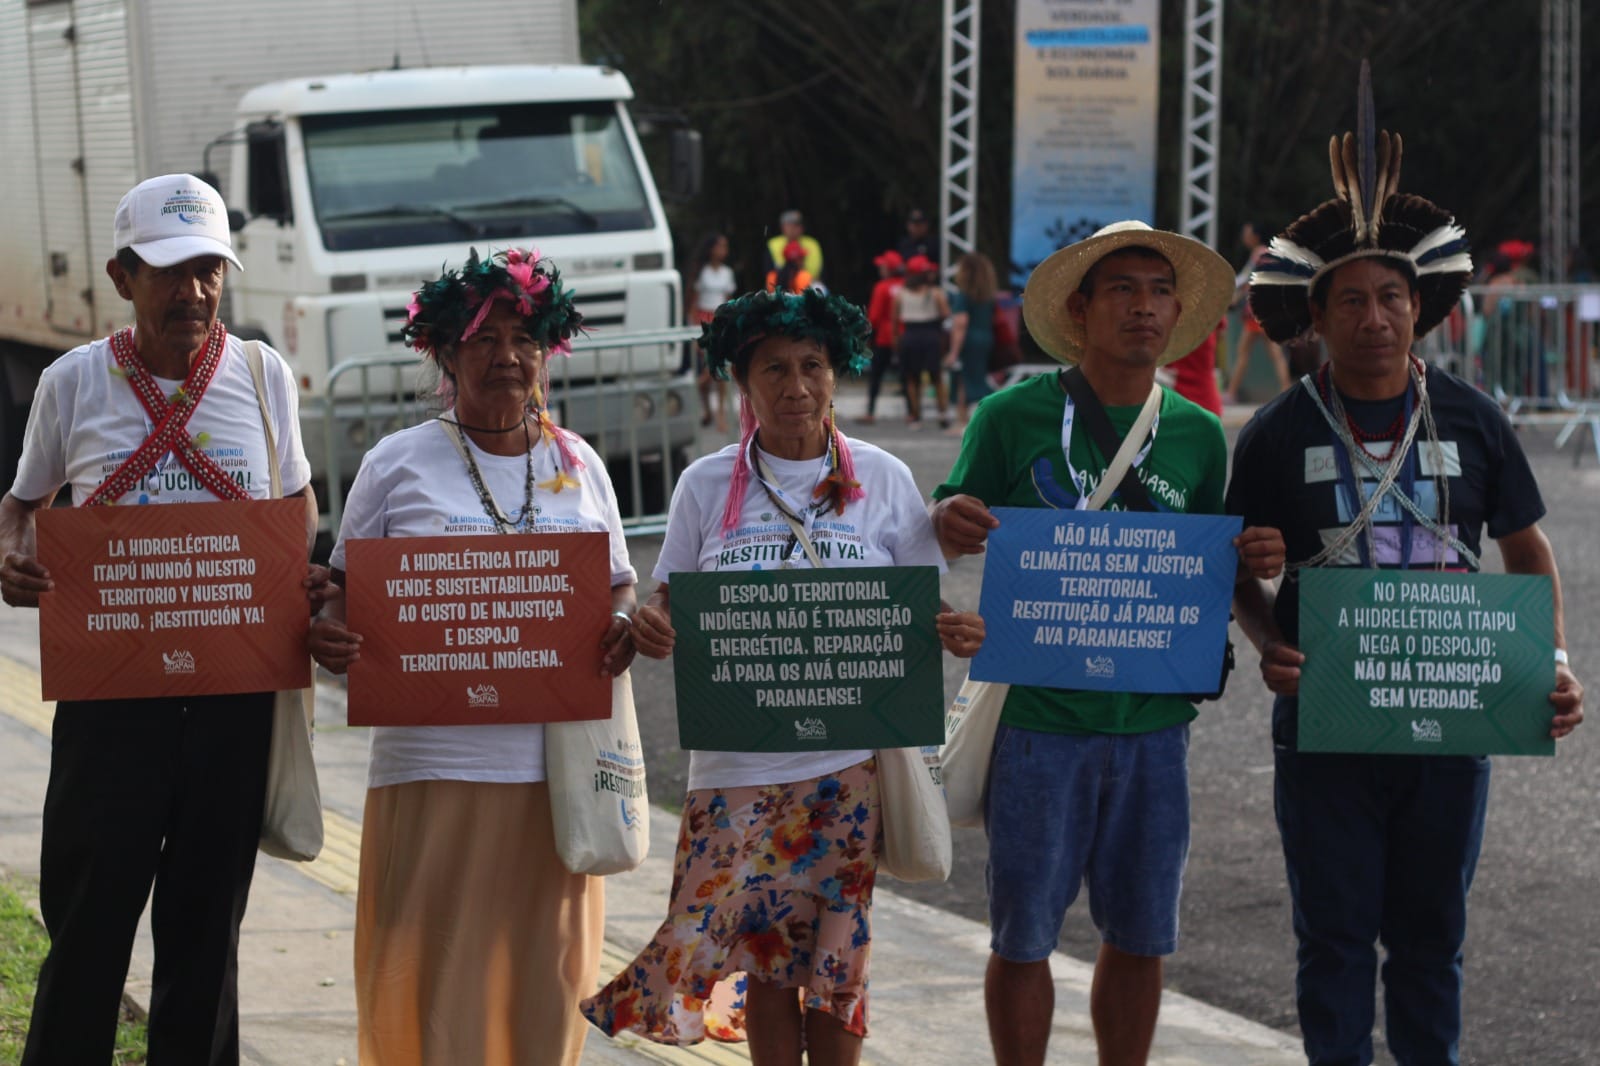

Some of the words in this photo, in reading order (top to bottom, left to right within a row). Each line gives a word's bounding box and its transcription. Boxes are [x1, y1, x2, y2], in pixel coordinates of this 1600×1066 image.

[221, 459, 248, 467] FUTURO
[444, 524, 478, 533] NUESTRO
[1054, 522, 1085, 546] NÃO
[1090, 523, 1110, 546] HÁ
[1114, 527, 1176, 552] JUSTIÇA
[108, 540, 126, 557] LA
[129, 533, 240, 556] HIDROELÉCTRICA
[837, 541, 864, 560] YA!
[94, 560, 136, 582] ITAIPÚ
[140, 558, 192, 580] INUNDÓ
[196, 558, 256, 578] NUESTRO
[400, 554, 410, 572] A
[414, 548, 512, 572] HIDRELÉTRICA
[515, 550, 560, 568] ITAIPU
[1020, 547, 1101, 572] CLIMÁTICA
[1104, 554, 1138, 573] SEM
[1142, 554, 1204, 579] JUSTIÇA
[98, 588, 176, 606] TERRITORIO
[180, 586, 188, 603] Y
[192, 583, 252, 602] NUESTRO
[386, 578, 432, 598] VENDE
[436, 574, 574, 596] SUSTENTABILIDADE,
[720, 584, 788, 604] DESPOJO
[792, 580, 890, 602] TERRITORIAL
[1060, 576, 1158, 599] TERRITORIAL.
[1374, 582, 1395, 602] NO
[1400, 583, 1481, 607] PARAGUAI,
[88, 612, 144, 632] FUTURO.
[149, 604, 240, 632] ¡RESTITUCIÓN
[243, 606, 265, 624] YA!
[398, 604, 416, 622] AO
[421, 602, 466, 622] CUSTO
[470, 602, 488, 620] DE
[492, 600, 565, 622] INJUSTIÇA
[700, 607, 772, 631] INDÍGENA
[776, 607, 808, 629] NÃO
[812, 606, 822, 628] É
[825, 604, 912, 630] TRANSIÇÃO
[1012, 599, 1110, 626] RESTITUIÇÃO
[1113, 600, 1132, 623] JÁ
[1136, 604, 1175, 624] PARA
[1179, 605, 1200, 625] OS
[1338, 608, 1349, 628] A
[1354, 606, 1463, 630] HIDRELÉTRICA
[1468, 610, 1516, 632] ITAIPU
[445, 628, 453, 646] E
[458, 626, 520, 646] DESPOJO
[710, 634, 808, 656] ENERGÉTICA.
[814, 631, 903, 656] REPARAÇÃO
[1033, 626, 1063, 646] AVA
[1066, 628, 1171, 649] PARANAENSE!
[1359, 634, 1400, 655] NEGA
[1406, 635, 1416, 655] O
[1422, 635, 1496, 657] DESPOJO:
[400, 652, 490, 672] TERRITORIAL
[492, 647, 563, 670] INDÍGENA.
[711, 660, 732, 682] JÁ
[735, 663, 775, 682] PARA
[780, 662, 800, 680] OS
[804, 658, 834, 680] AVÁ
[837, 659, 905, 679] GUARANI
[1354, 658, 1386, 681] NÃO
[1390, 657, 1412, 682] HÁ
[1416, 660, 1502, 687] TRANSIÇÃO
[756, 686, 862, 708] PARANAENSE!
[1370, 688, 1404, 708] SEM
[1408, 688, 1484, 710] VERDADE.
